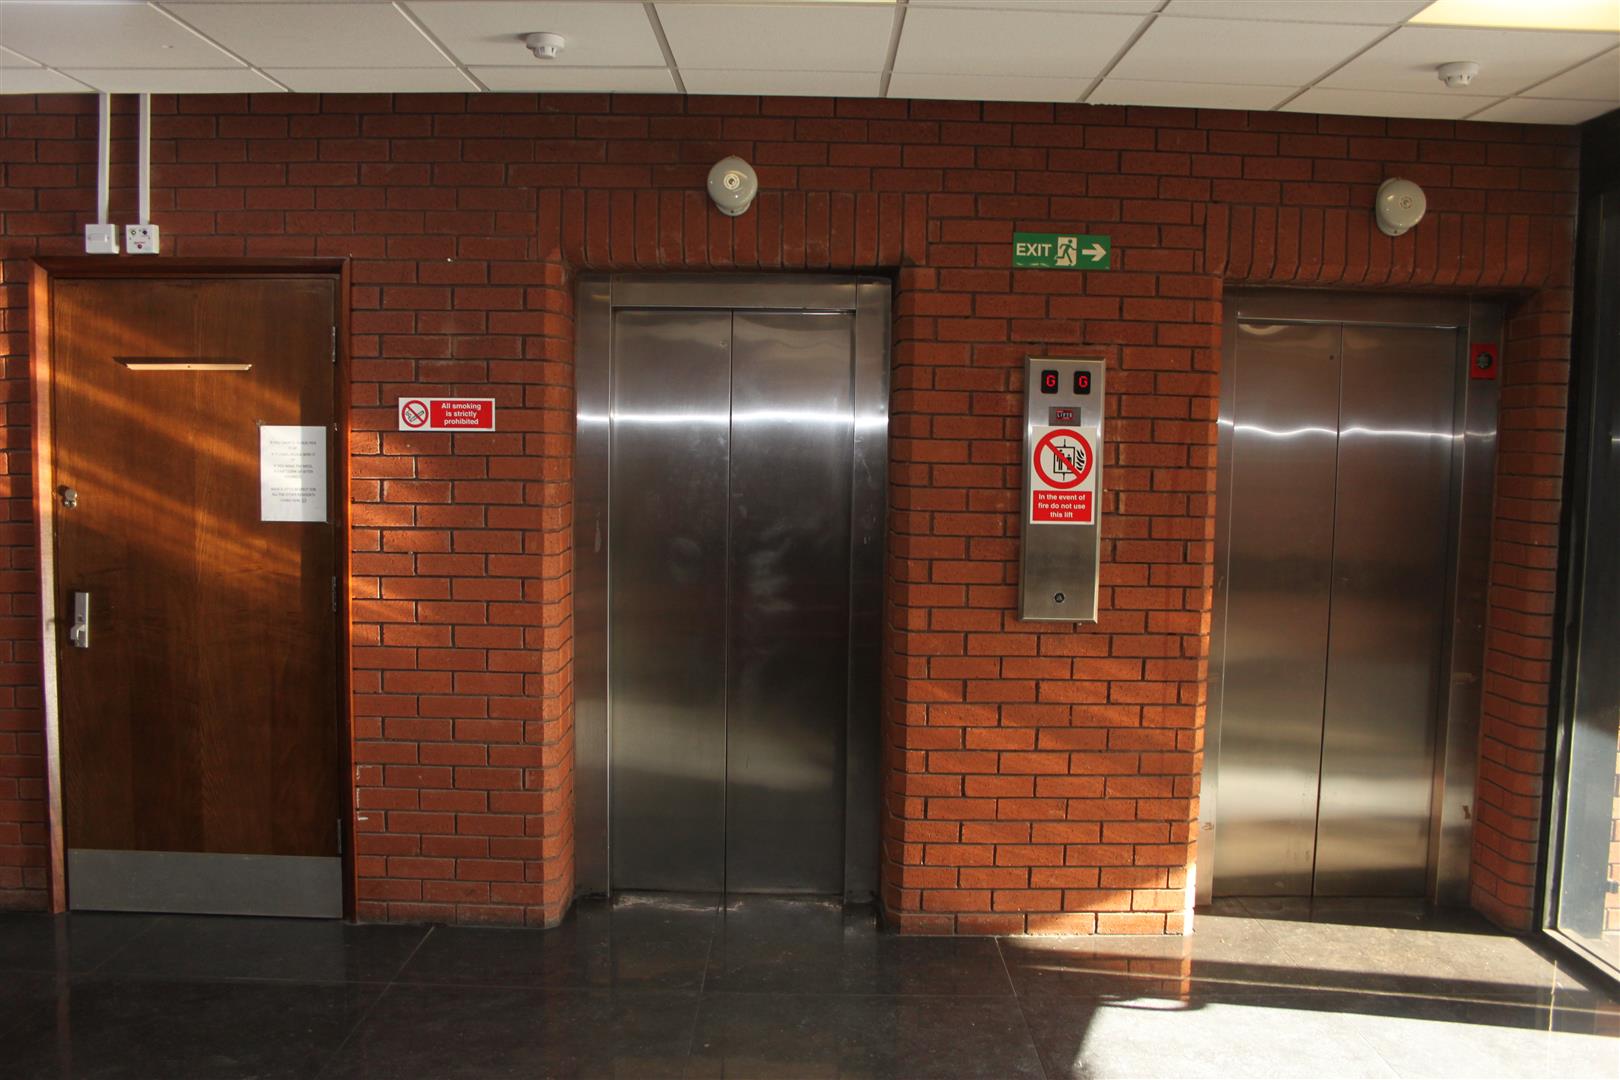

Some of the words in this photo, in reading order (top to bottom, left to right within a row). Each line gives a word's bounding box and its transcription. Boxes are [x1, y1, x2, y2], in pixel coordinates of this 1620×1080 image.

[1016, 243, 1052, 257] EXIT
[1046, 374, 1056, 388] G
[1078, 375, 1089, 388] G
[452, 403, 482, 411] smoking
[444, 418, 479, 426] prohibited
